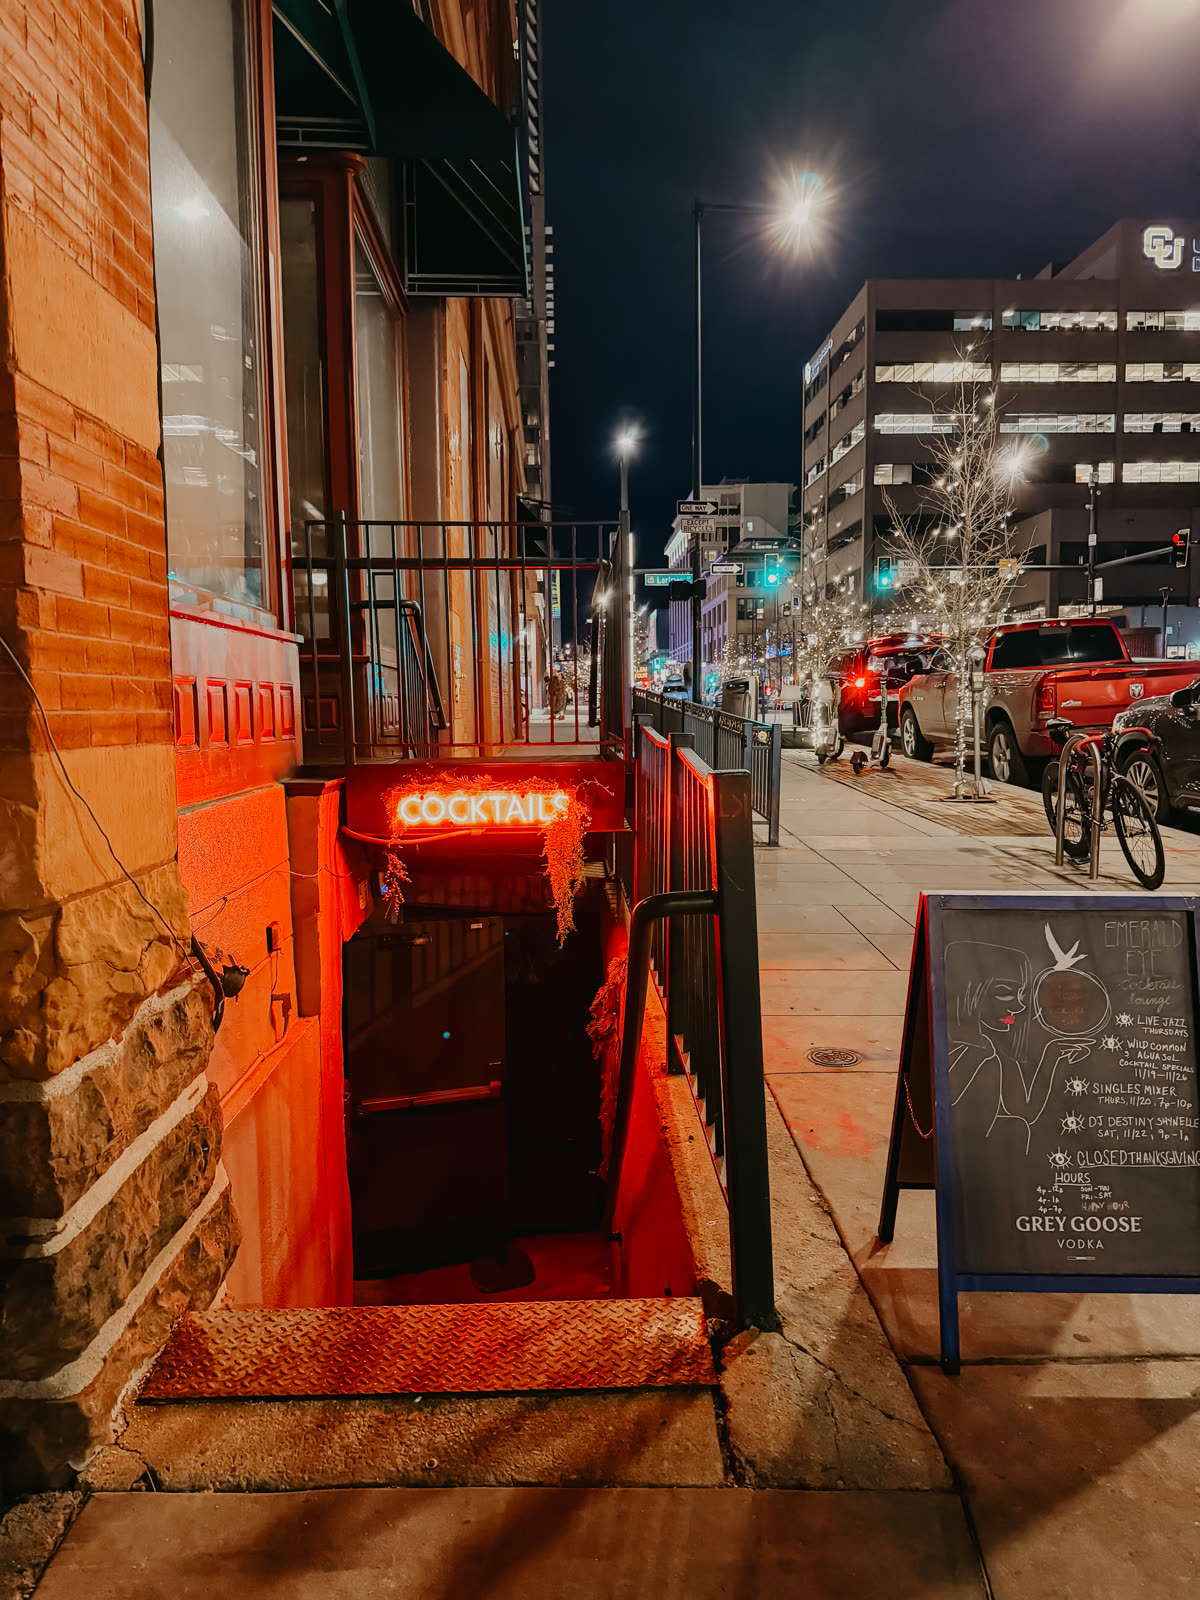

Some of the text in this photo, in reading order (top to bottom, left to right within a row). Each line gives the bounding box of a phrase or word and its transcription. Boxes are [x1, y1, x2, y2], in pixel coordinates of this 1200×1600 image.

[1104, 919, 1183, 948] EMERALD
[1126, 949, 1163, 977] EYE
[1137, 1014, 1188, 1028] LIVE JAZZ
[1141, 1027, 1189, 1038] THURSDAYS
[1126, 1038, 1187, 1053] WILD COMMON
[1137, 1050, 1161, 1061] AGUA
[1118, 1058, 1195, 1073] COCKTAIL SPECIALS
[1092, 1082, 1178, 1097] SINGLES MIXER
[1088, 1115, 1200, 1130] DJ DESTINY SHYNELLE
[1077, 1149, 1200, 1167] CLOSED THANKSGIVING
[1055, 1172, 1091, 1183] HOURS
[1015, 1216, 1143, 1232] GREY GOOSE
[1056, 1239, 1105, 1250] VODKA
